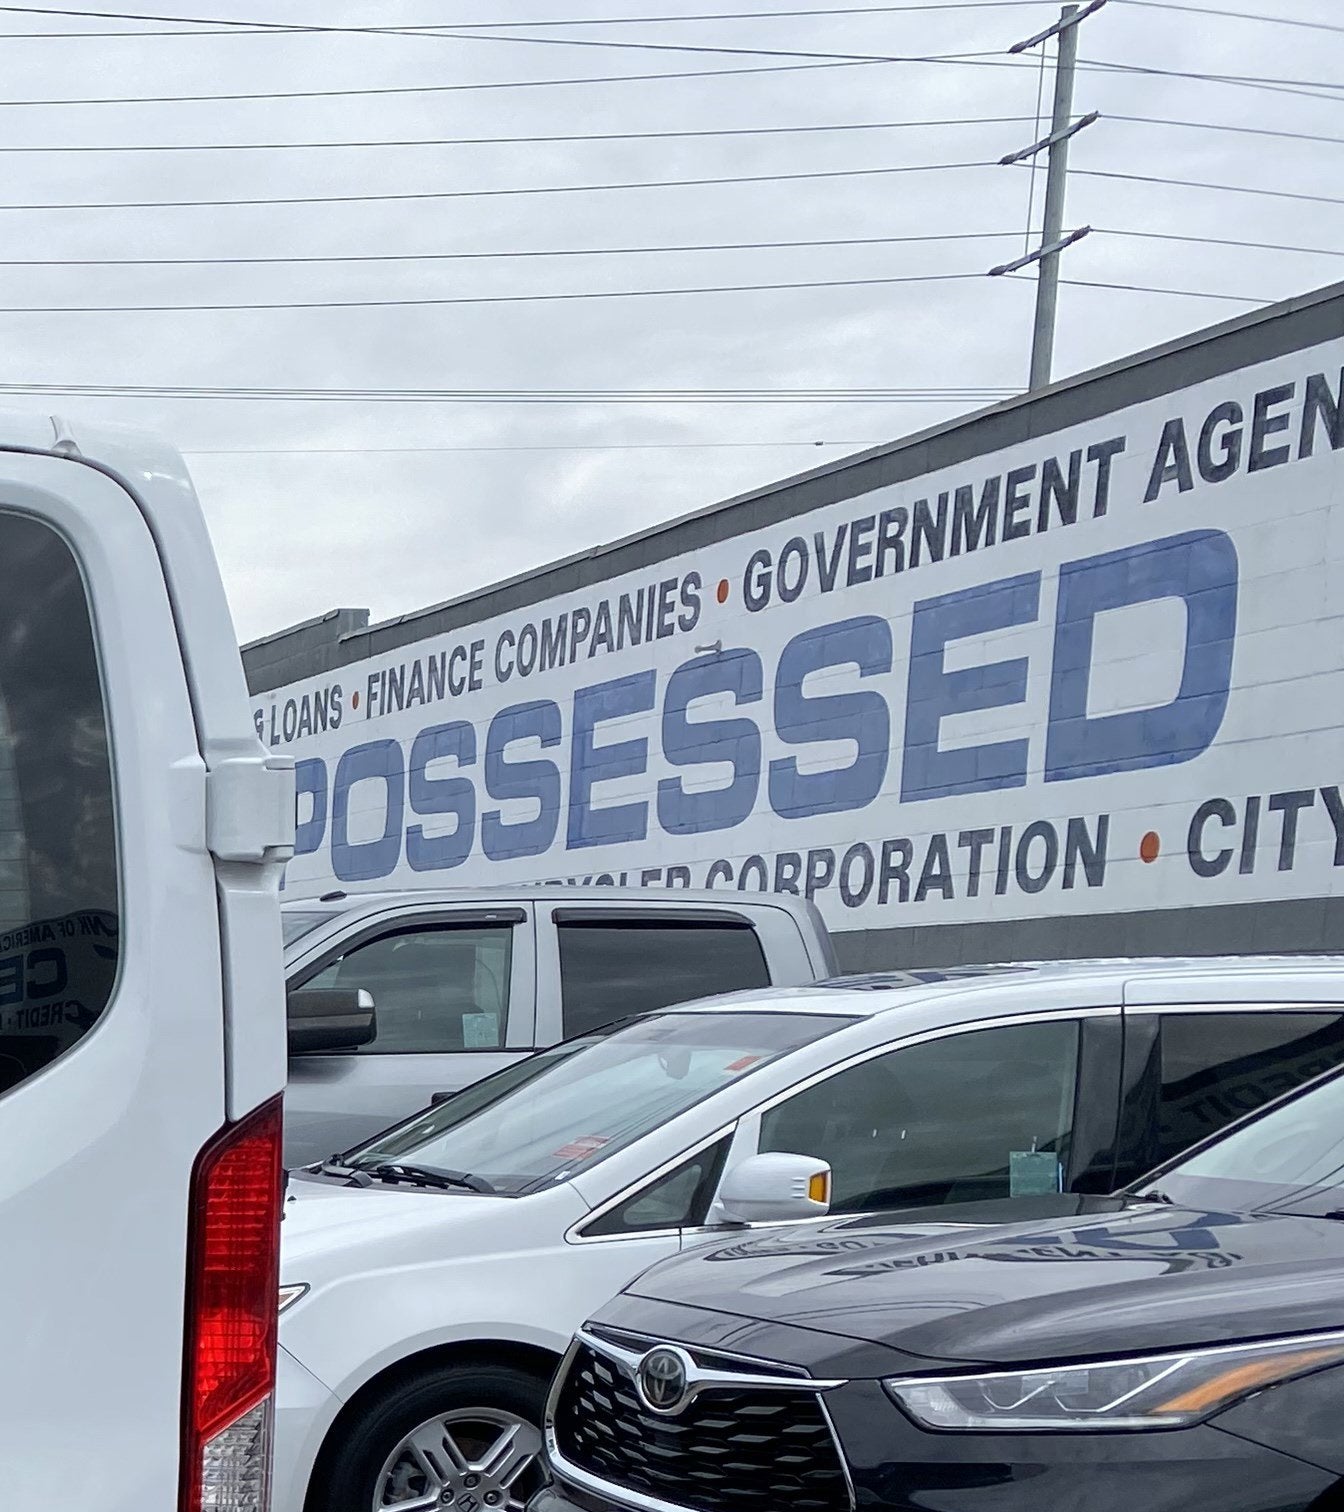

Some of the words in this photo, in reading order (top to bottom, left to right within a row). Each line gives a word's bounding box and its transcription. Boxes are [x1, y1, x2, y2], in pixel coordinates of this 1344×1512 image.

[270, 684, 343, 746] LOANS
[366, 639, 485, 719] FINANCE
[494, 571, 702, 683] COMPANIES
[743, 435, 1127, 612] GOVERNMENT
[705, 813, 1110, 908] CORPORATION
